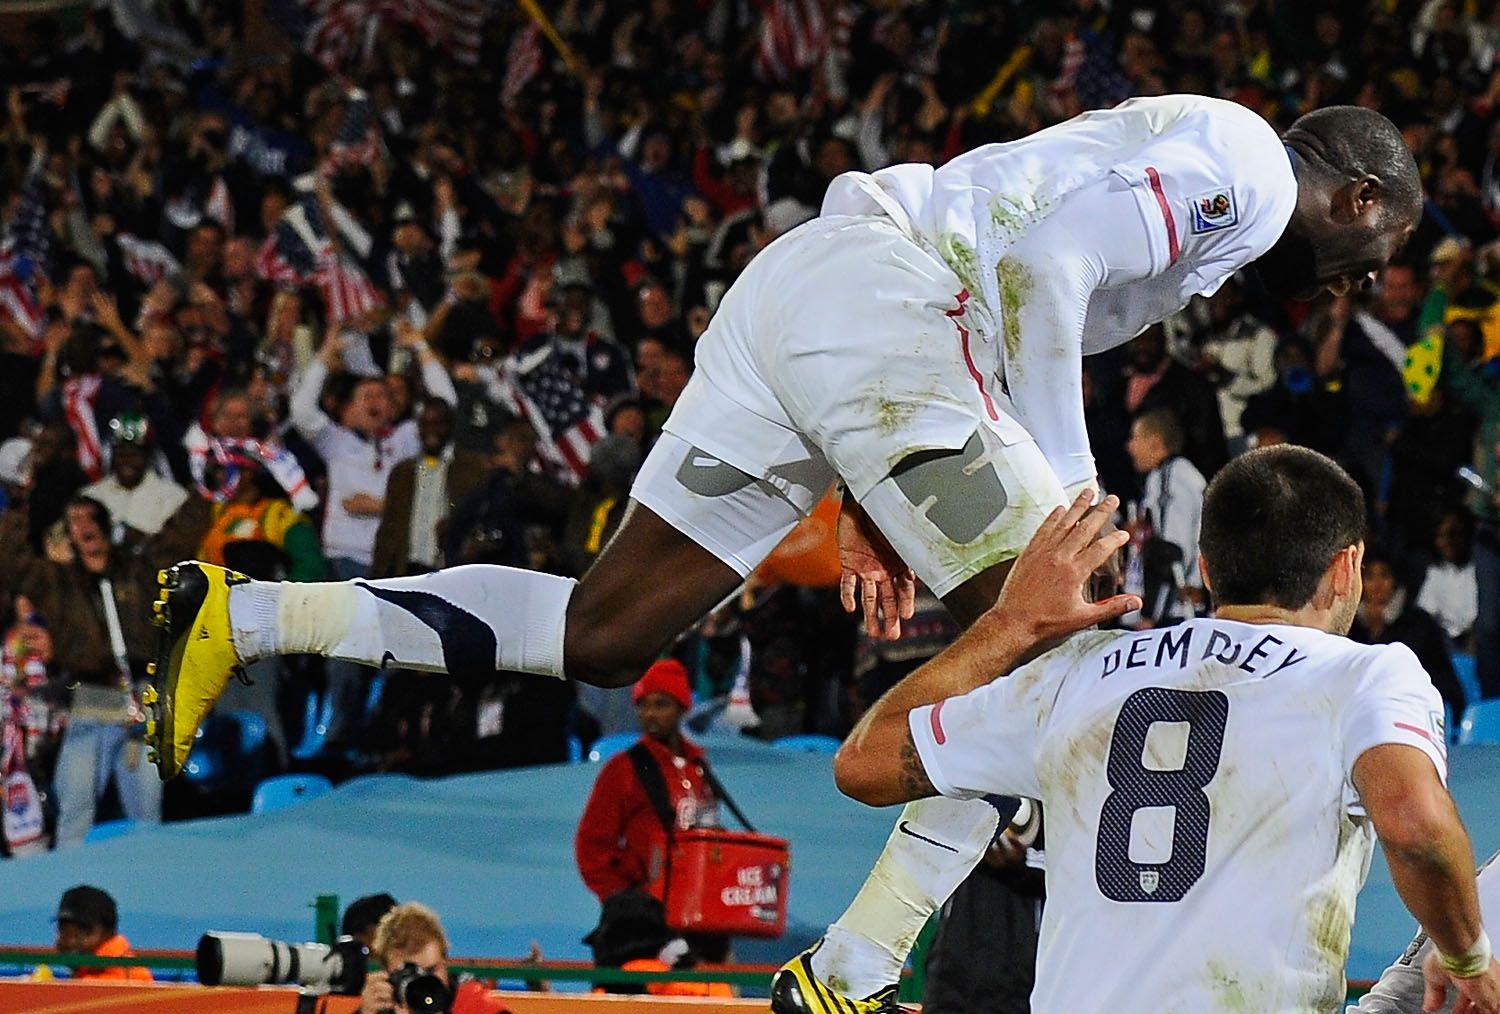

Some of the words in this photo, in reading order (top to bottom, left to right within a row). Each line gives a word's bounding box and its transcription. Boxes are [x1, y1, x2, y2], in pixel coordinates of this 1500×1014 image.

[1095, 687, 1229, 902] 8
[737, 866, 763, 886] ICE
[721, 886, 778, 906] CREAM
